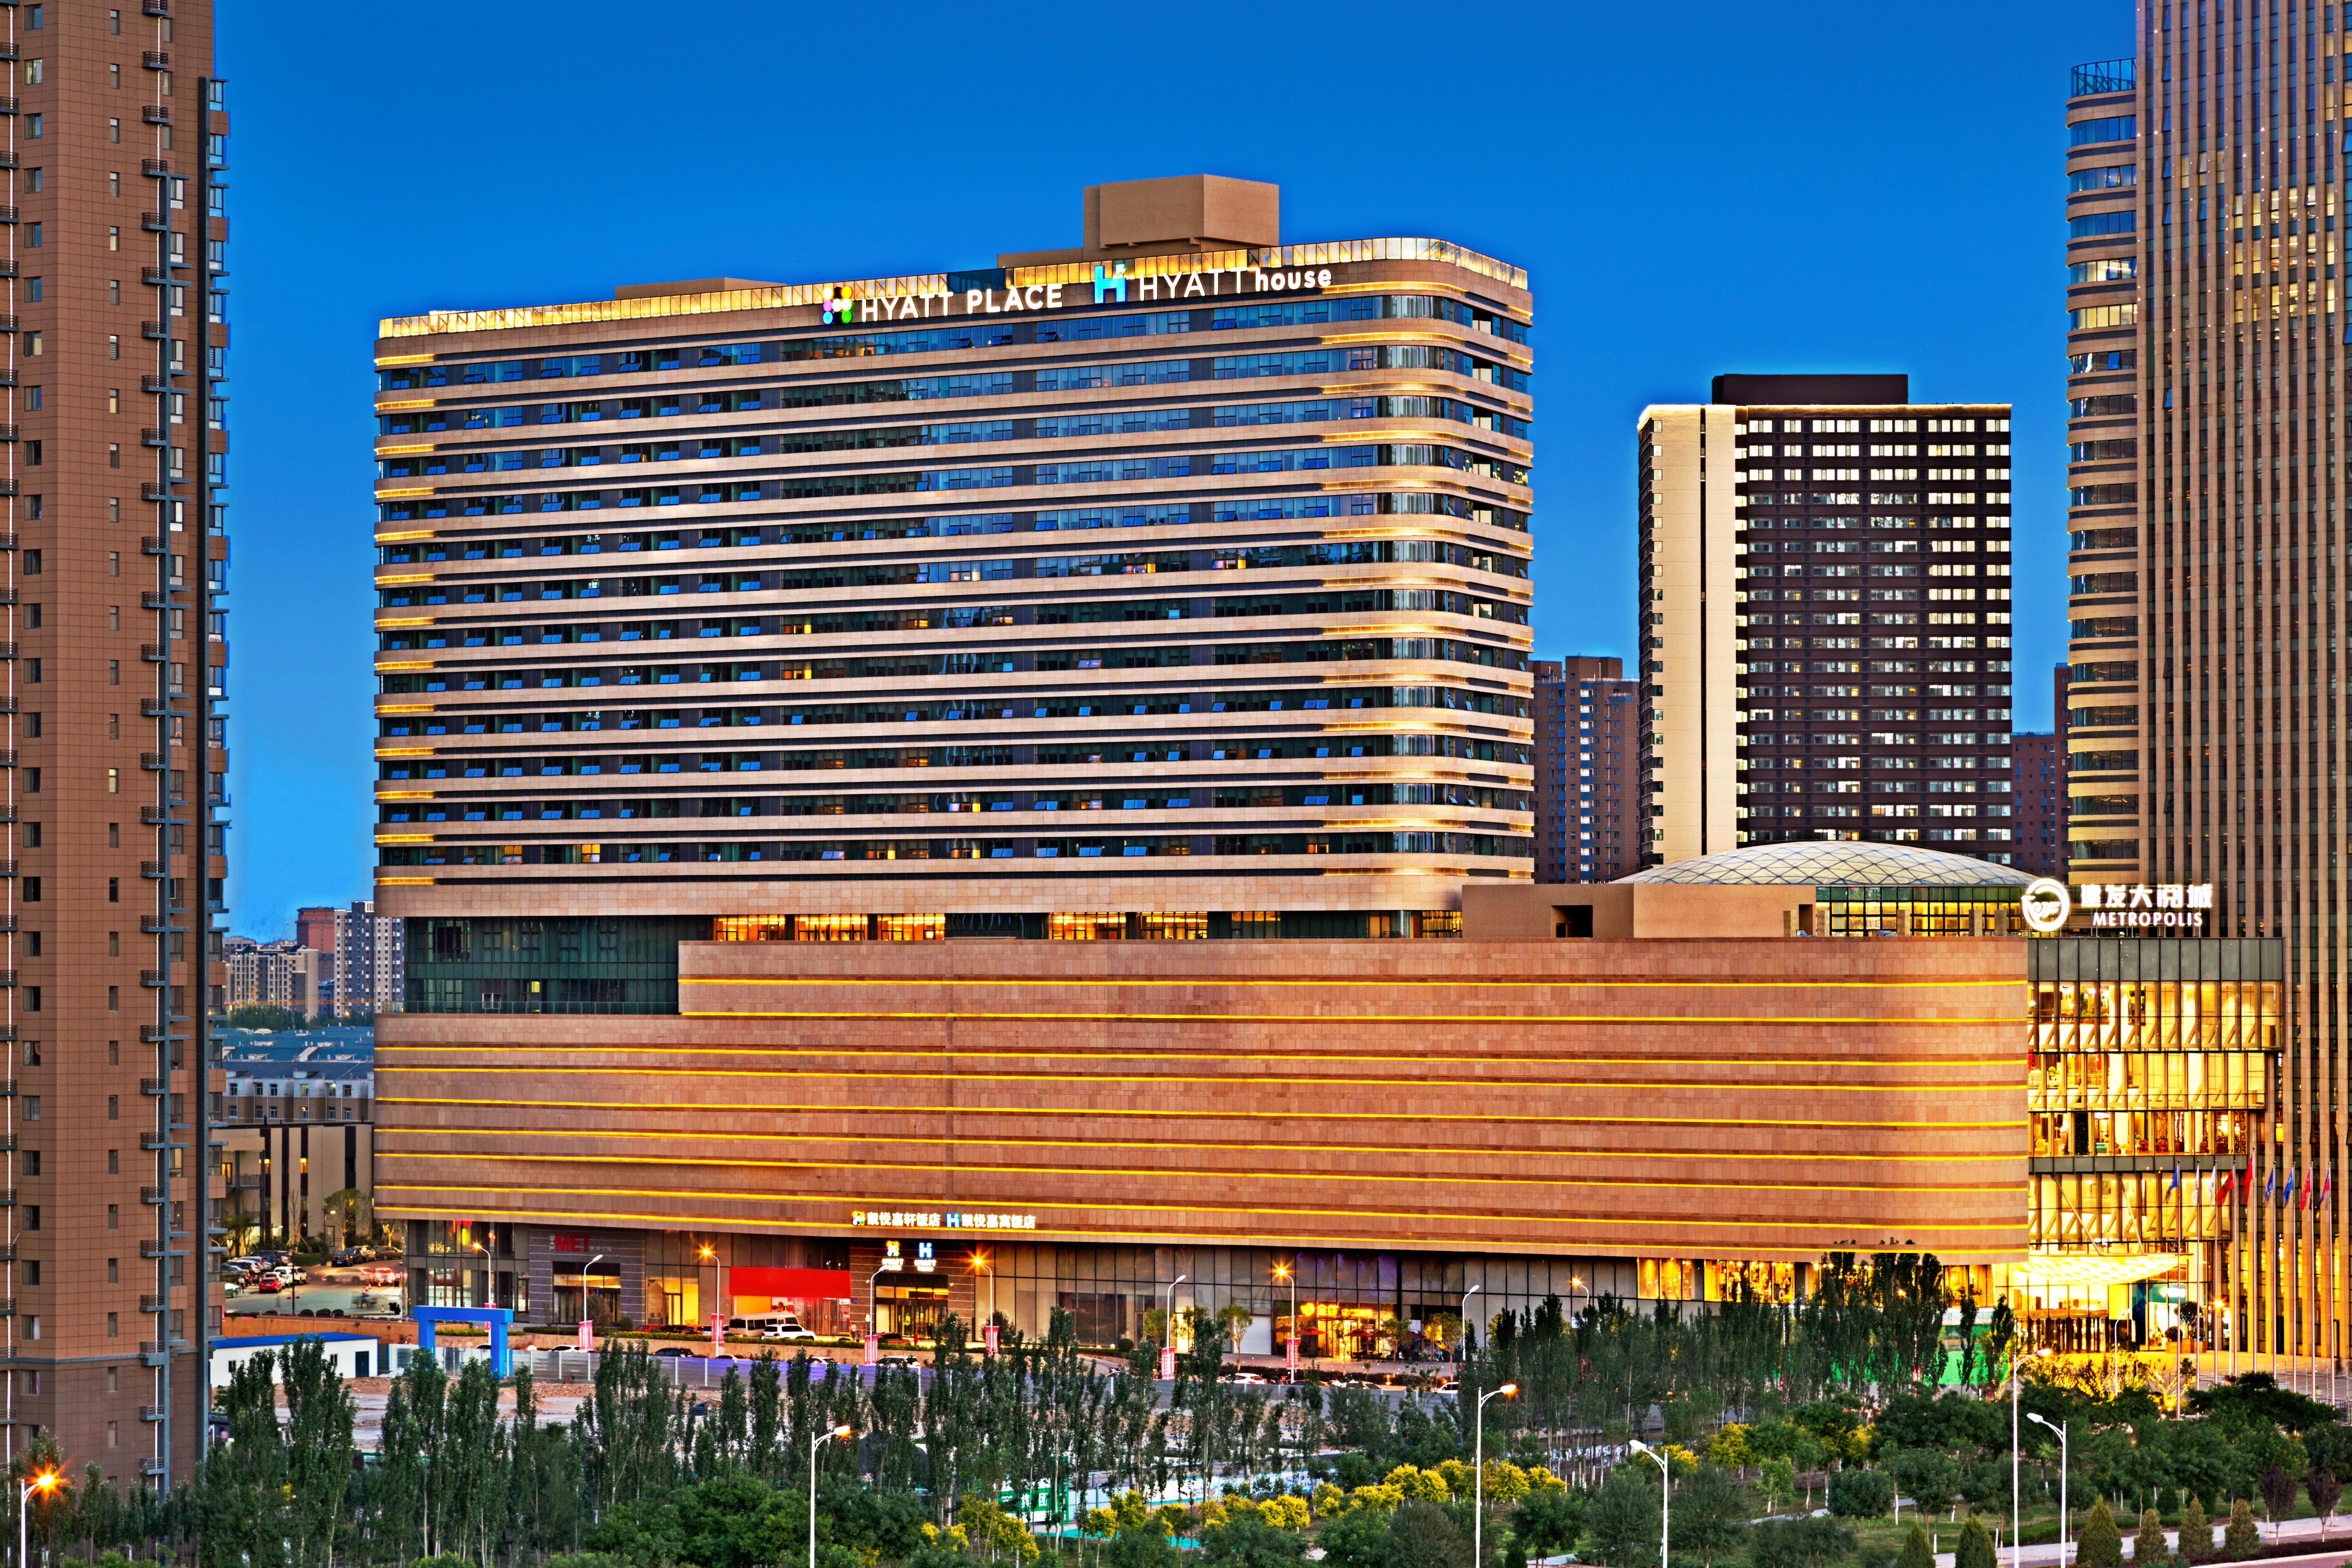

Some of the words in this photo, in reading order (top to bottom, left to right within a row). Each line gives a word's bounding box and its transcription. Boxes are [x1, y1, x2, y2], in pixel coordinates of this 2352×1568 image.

[1140, 267, 1247, 301] HYATT
[1254, 267, 1332, 292] house
[862, 291, 954, 322] HYATT
[967, 283, 1062, 314] PLACE
[2081, 884, 2212, 908] 建发大阅城
[2093, 912, 2203, 926] METROPOLIS
[556, 1233, 591, 1252] MET
